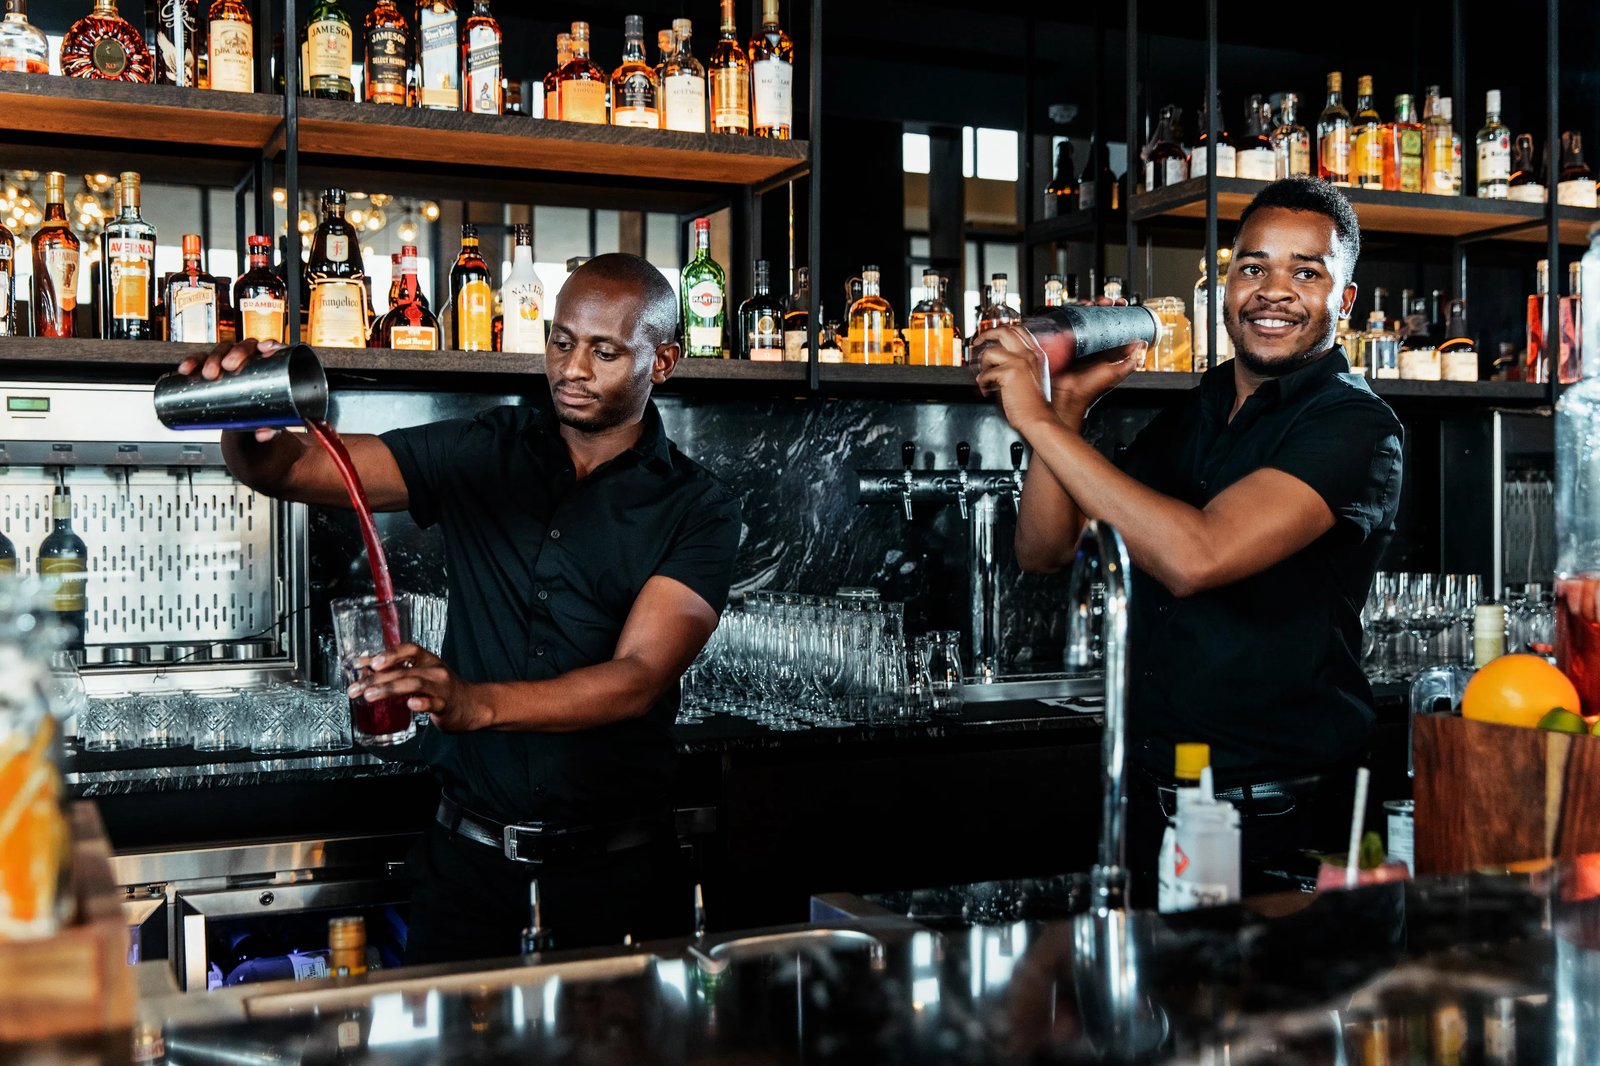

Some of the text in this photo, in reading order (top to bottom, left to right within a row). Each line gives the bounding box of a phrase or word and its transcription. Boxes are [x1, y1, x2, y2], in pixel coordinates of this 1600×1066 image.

[312, 25, 350, 39] JAMESON
[371, 31, 406, 45] JAMESON
[110, 242, 153, 255] AVERNA
[319, 294, 359, 309] Frangelico
